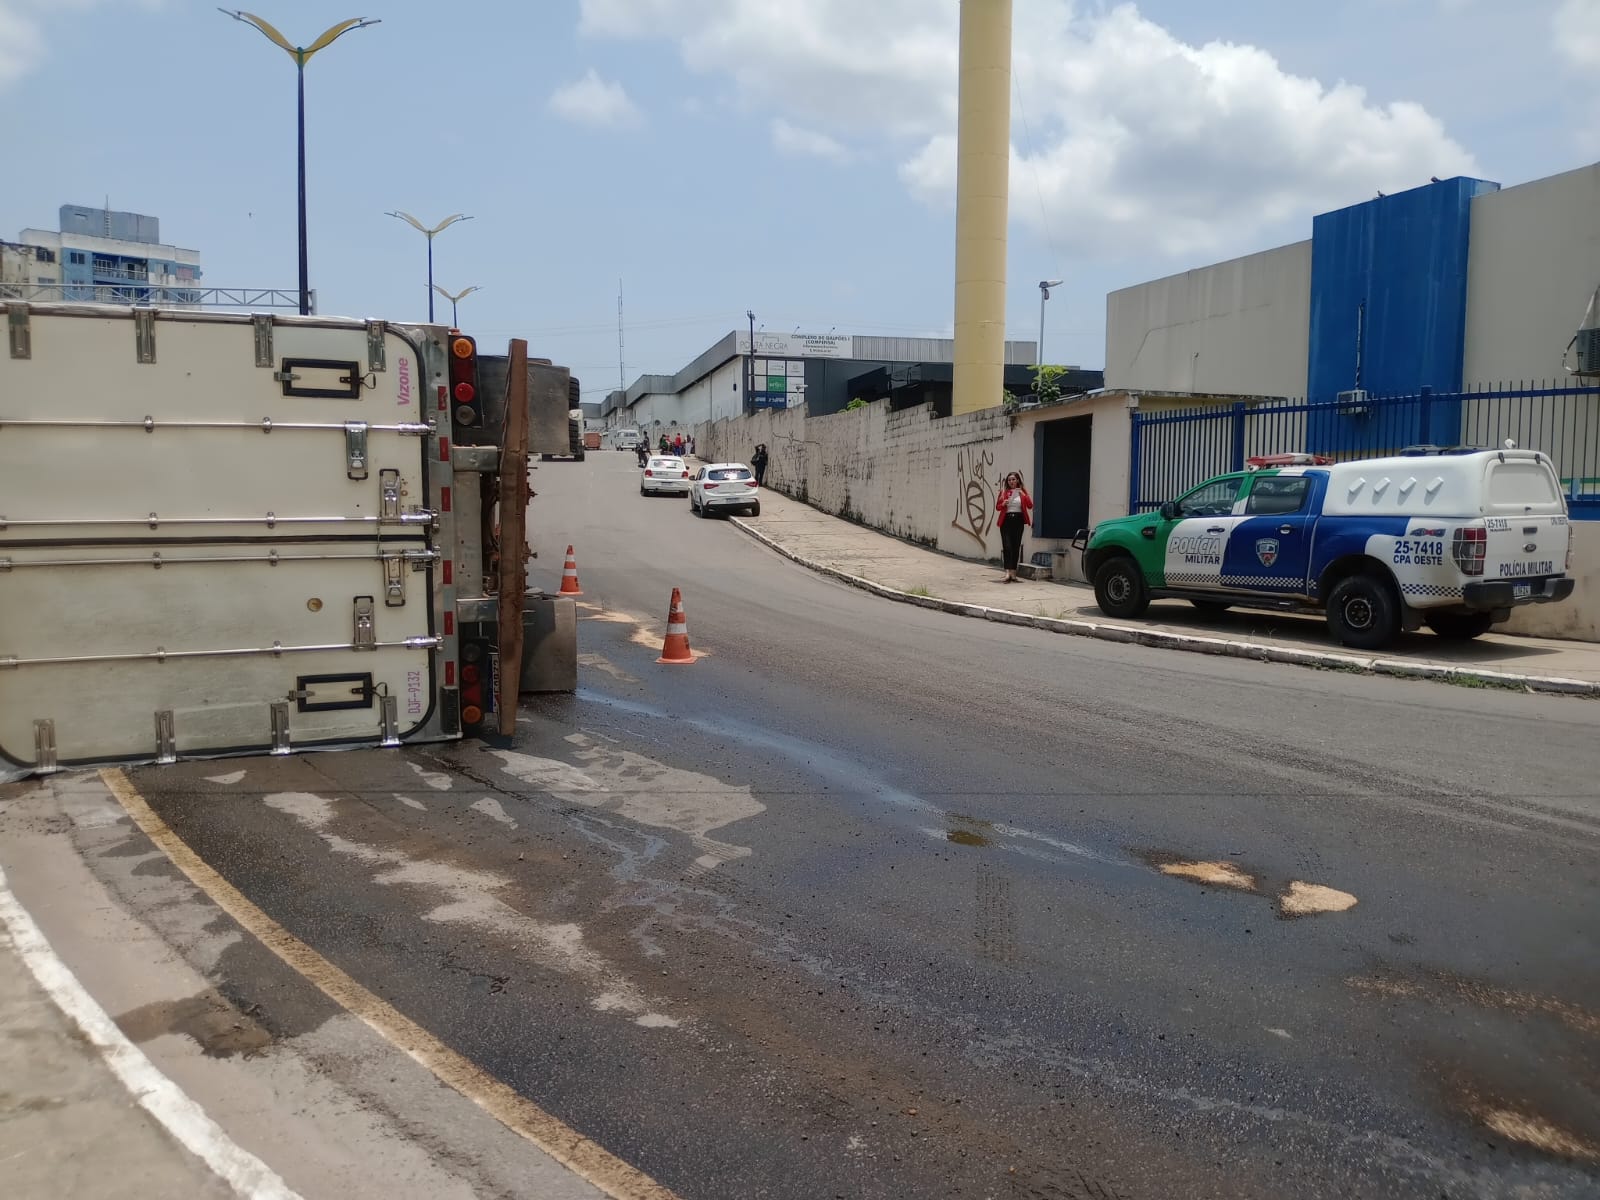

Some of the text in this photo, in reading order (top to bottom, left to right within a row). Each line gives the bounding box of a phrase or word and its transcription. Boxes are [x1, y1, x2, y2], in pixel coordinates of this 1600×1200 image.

[1169, 535, 1220, 555] POLÍCIA
[1394, 541, 1443, 555] 25-7418
[1185, 555, 1220, 565] MILITAR
[1393, 555, 1443, 566] CPA OESTE
[1500, 560, 1553, 577] POLÍCIA MILITAR
